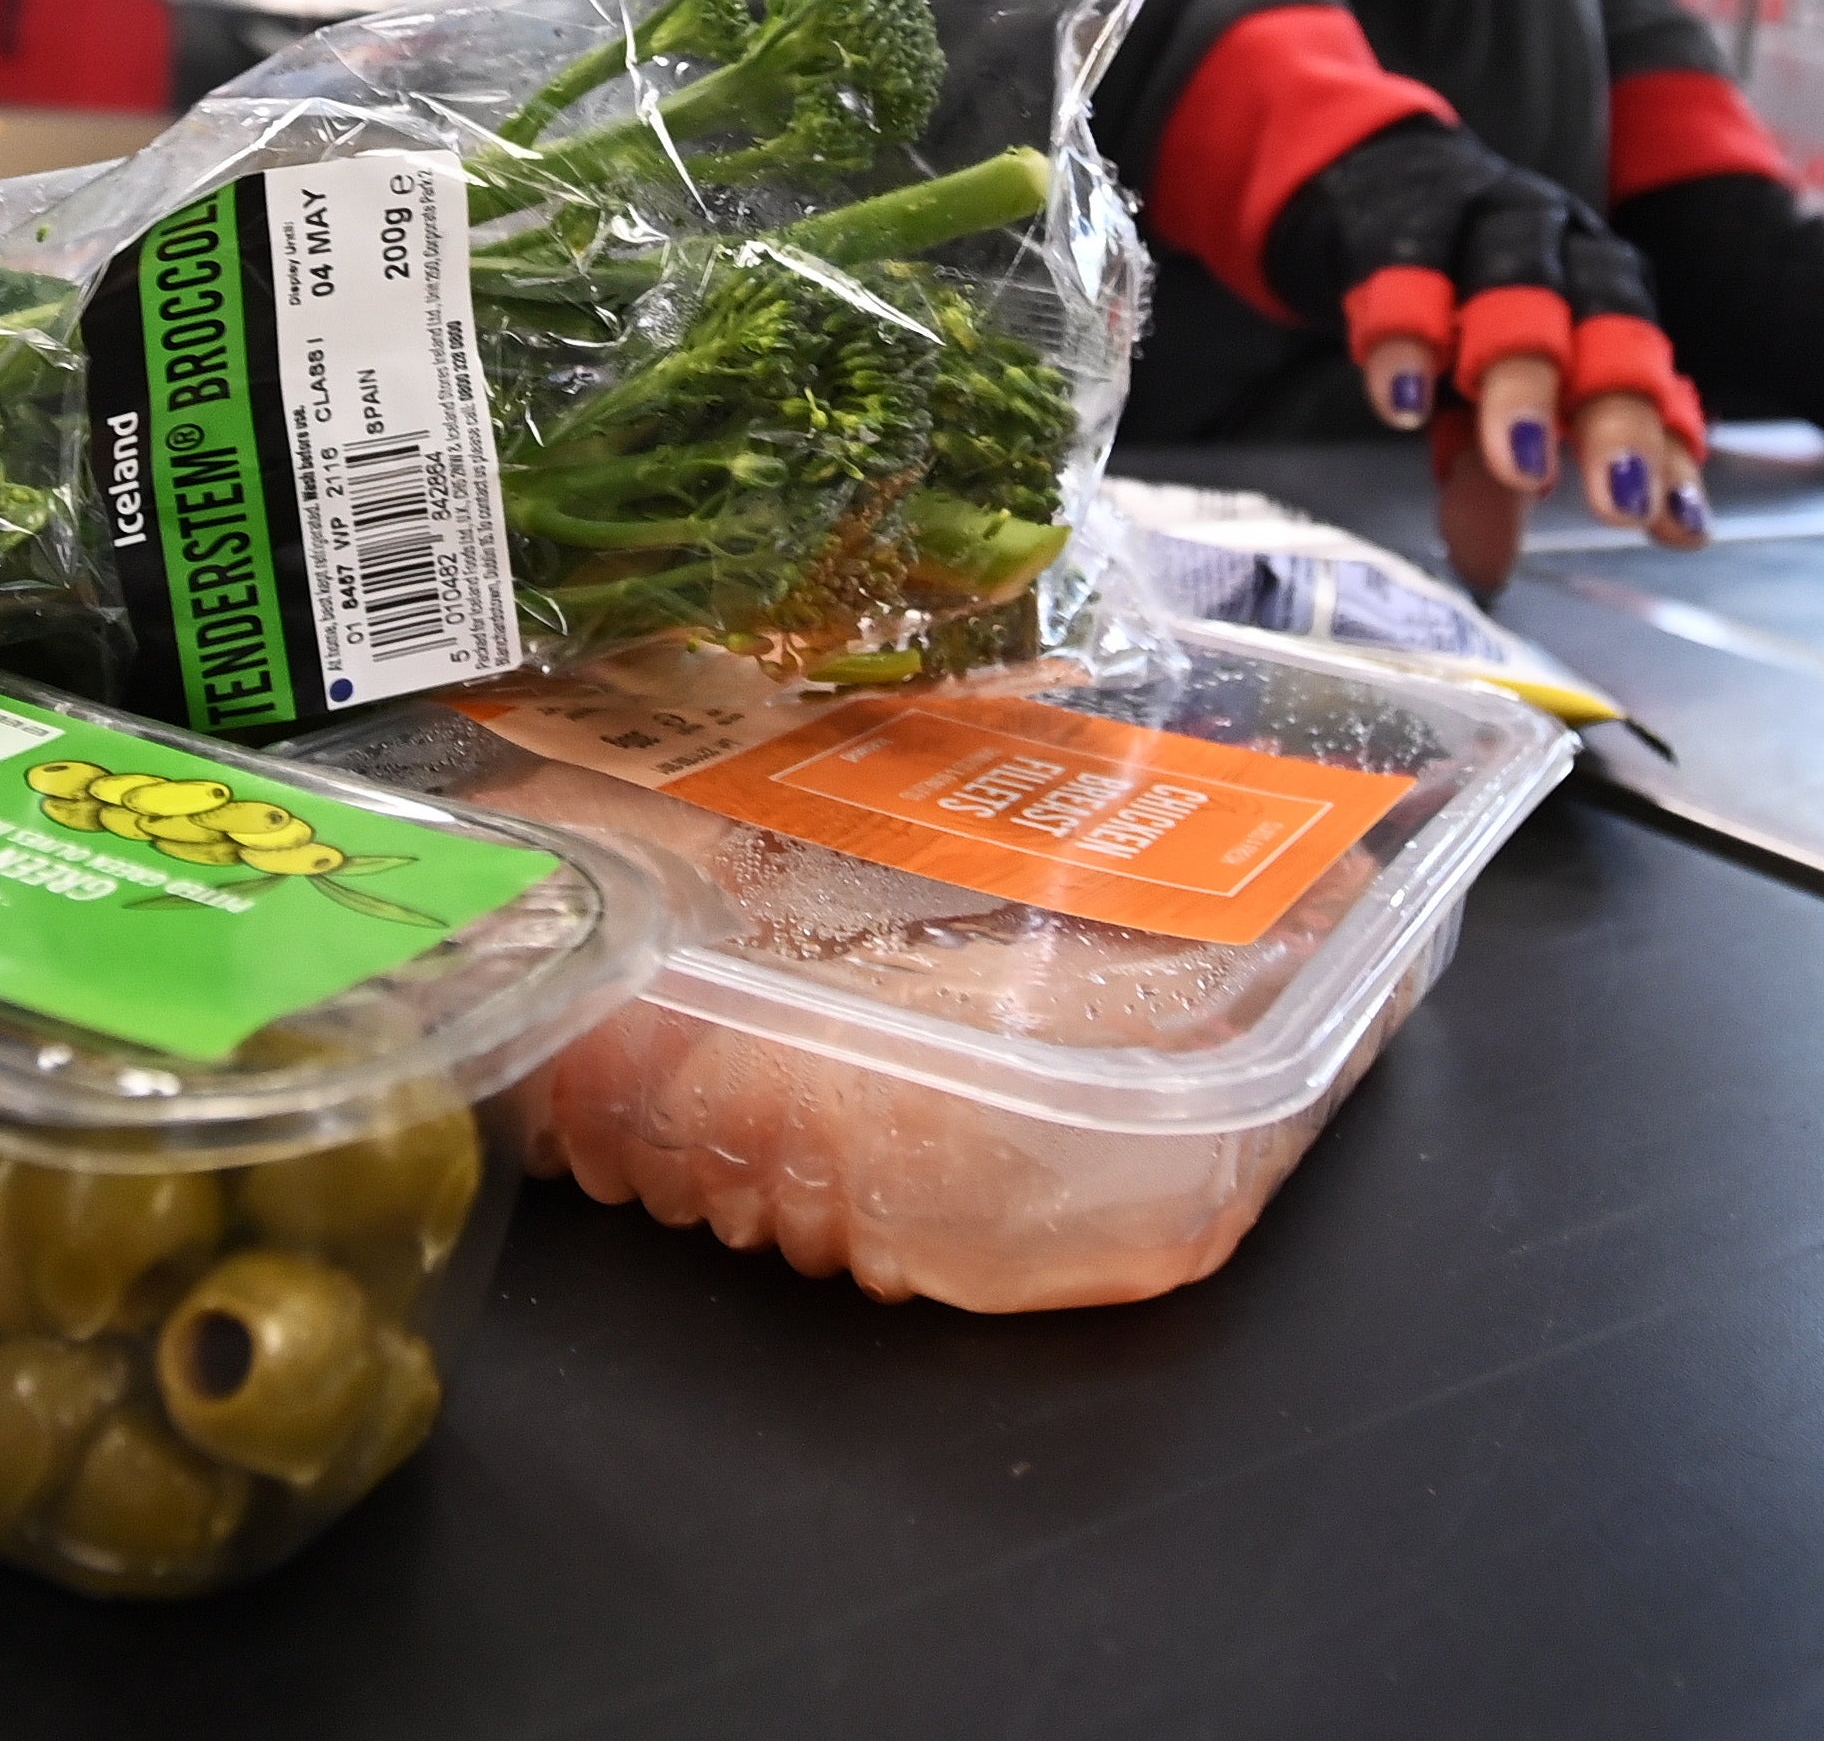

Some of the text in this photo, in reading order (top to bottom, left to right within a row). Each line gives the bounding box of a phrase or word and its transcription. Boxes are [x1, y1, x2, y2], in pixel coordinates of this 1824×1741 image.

[305, 187, 336, 297] 04 MAY
[381, 206, 413, 281] 200g
[287, 258, 302, 306] Display
[359, 369, 387, 436] SPAIN
[106, 411, 146, 548] Iceland
[294, 431, 315, 470] before
[299, 471, 319, 501] Wash
[438, 552, 466, 626] 010482
[937, 755, 1067, 819] FILLETS
[1009, 771, 1133, 839] BREAST
[1073, 782, 1209, 861] CHICKEN
